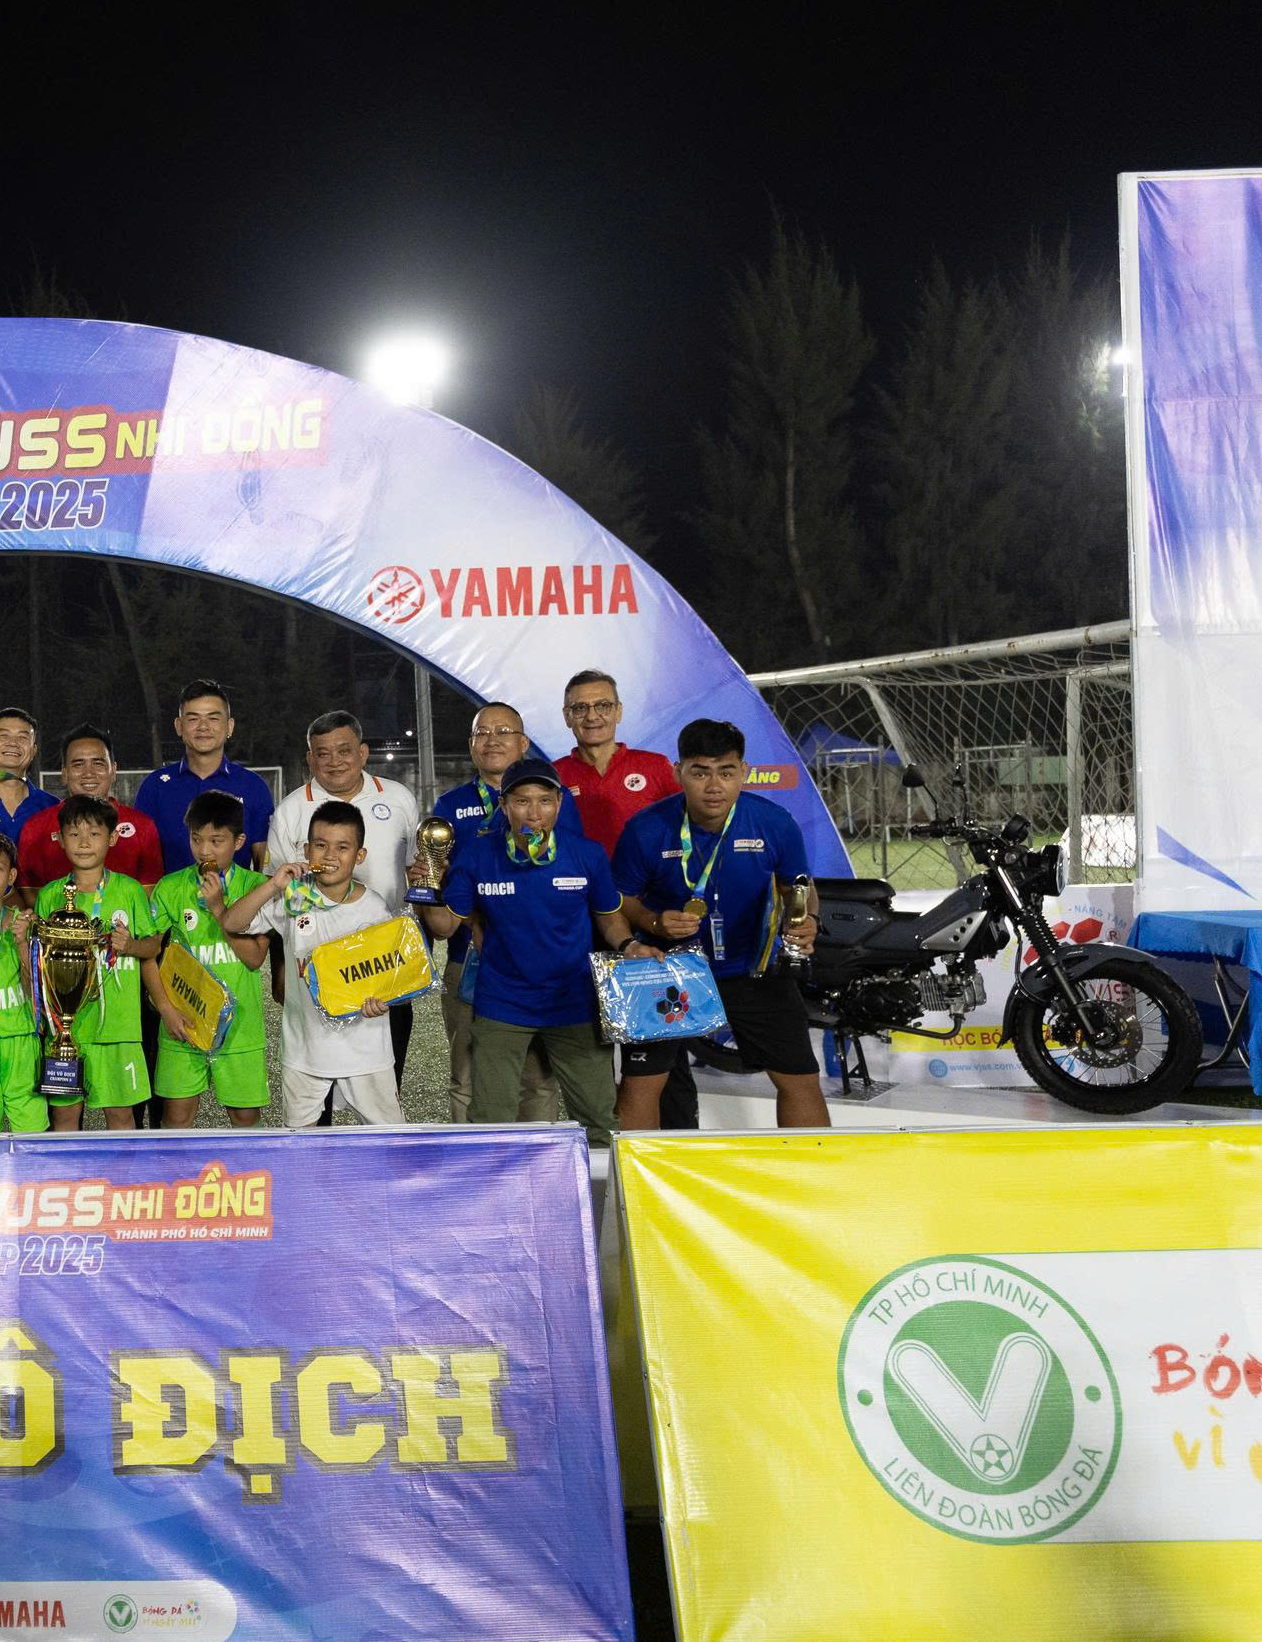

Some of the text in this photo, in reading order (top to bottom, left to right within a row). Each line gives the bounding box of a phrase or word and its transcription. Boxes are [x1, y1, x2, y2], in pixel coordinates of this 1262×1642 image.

[115, 416, 185, 459] NHI
[429, 564, 639, 618] YAMAHA
[477, 881, 515, 896] COACH
[337, 950, 407, 985] YAMAHA
[124, 1061, 137, 1091] 1
[110, 1188, 164, 1221] NHI
[174, 1167, 266, 1219] ĐỒNG
[235, 1226, 268, 1238] MINH
[19, 1234, 106, 1276] 2025
[868, 1268, 1049, 1326] TP HỒ CHÍ MINH
[116, 1352, 511, 1497] ĐỊCH
[882, 1444, 1104, 1531] LIÊN ĐOÀN BÓNG ĐÁ
